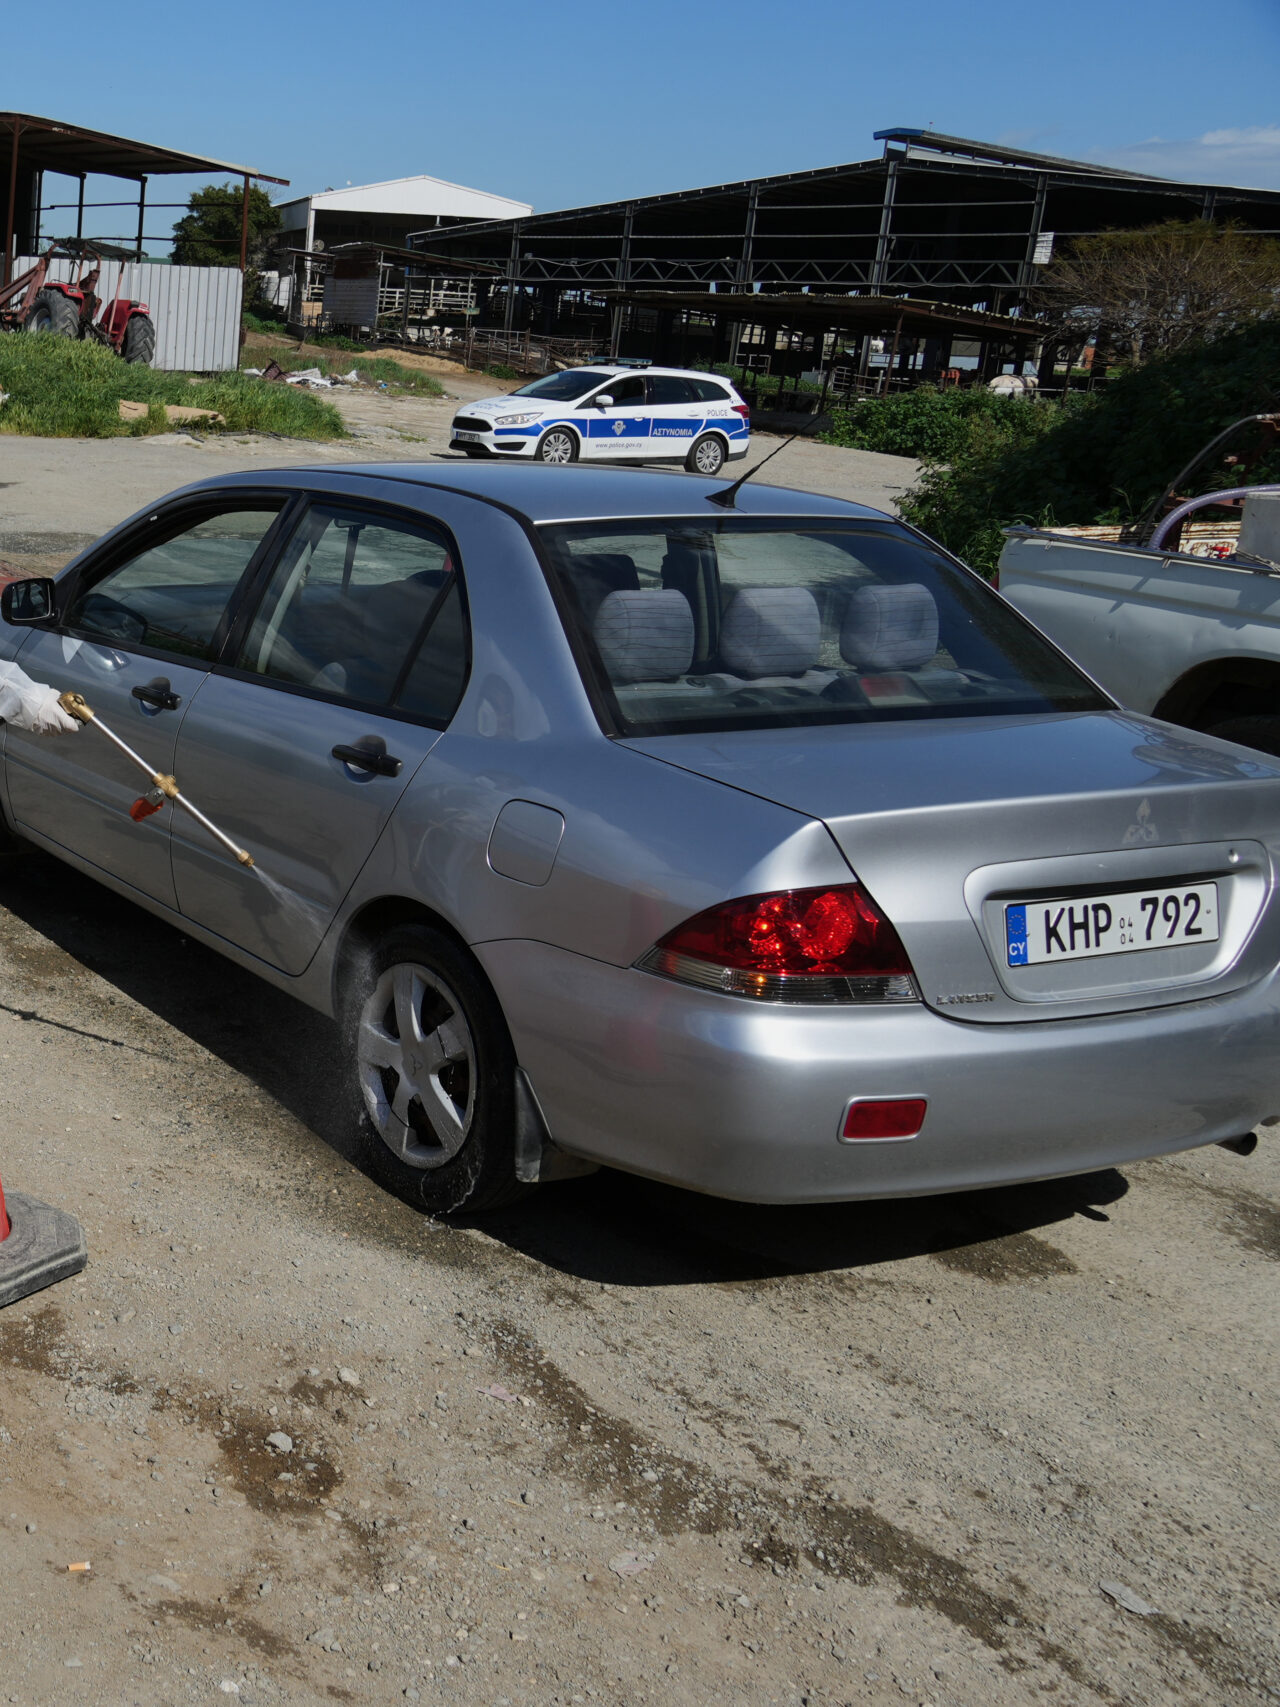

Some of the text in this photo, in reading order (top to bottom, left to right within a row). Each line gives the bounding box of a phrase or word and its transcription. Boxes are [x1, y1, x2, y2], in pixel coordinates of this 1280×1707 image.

[707, 409, 728, 417] POLICE
[652, 428, 693, 436] ΑΣΤΥΝΟΜΙΑ
[1044, 892, 1203, 954] KHP 792
[1120, 915, 1134, 929] 04
[1120, 932, 1135, 946] 04
[1008, 941, 1026, 957] CY
